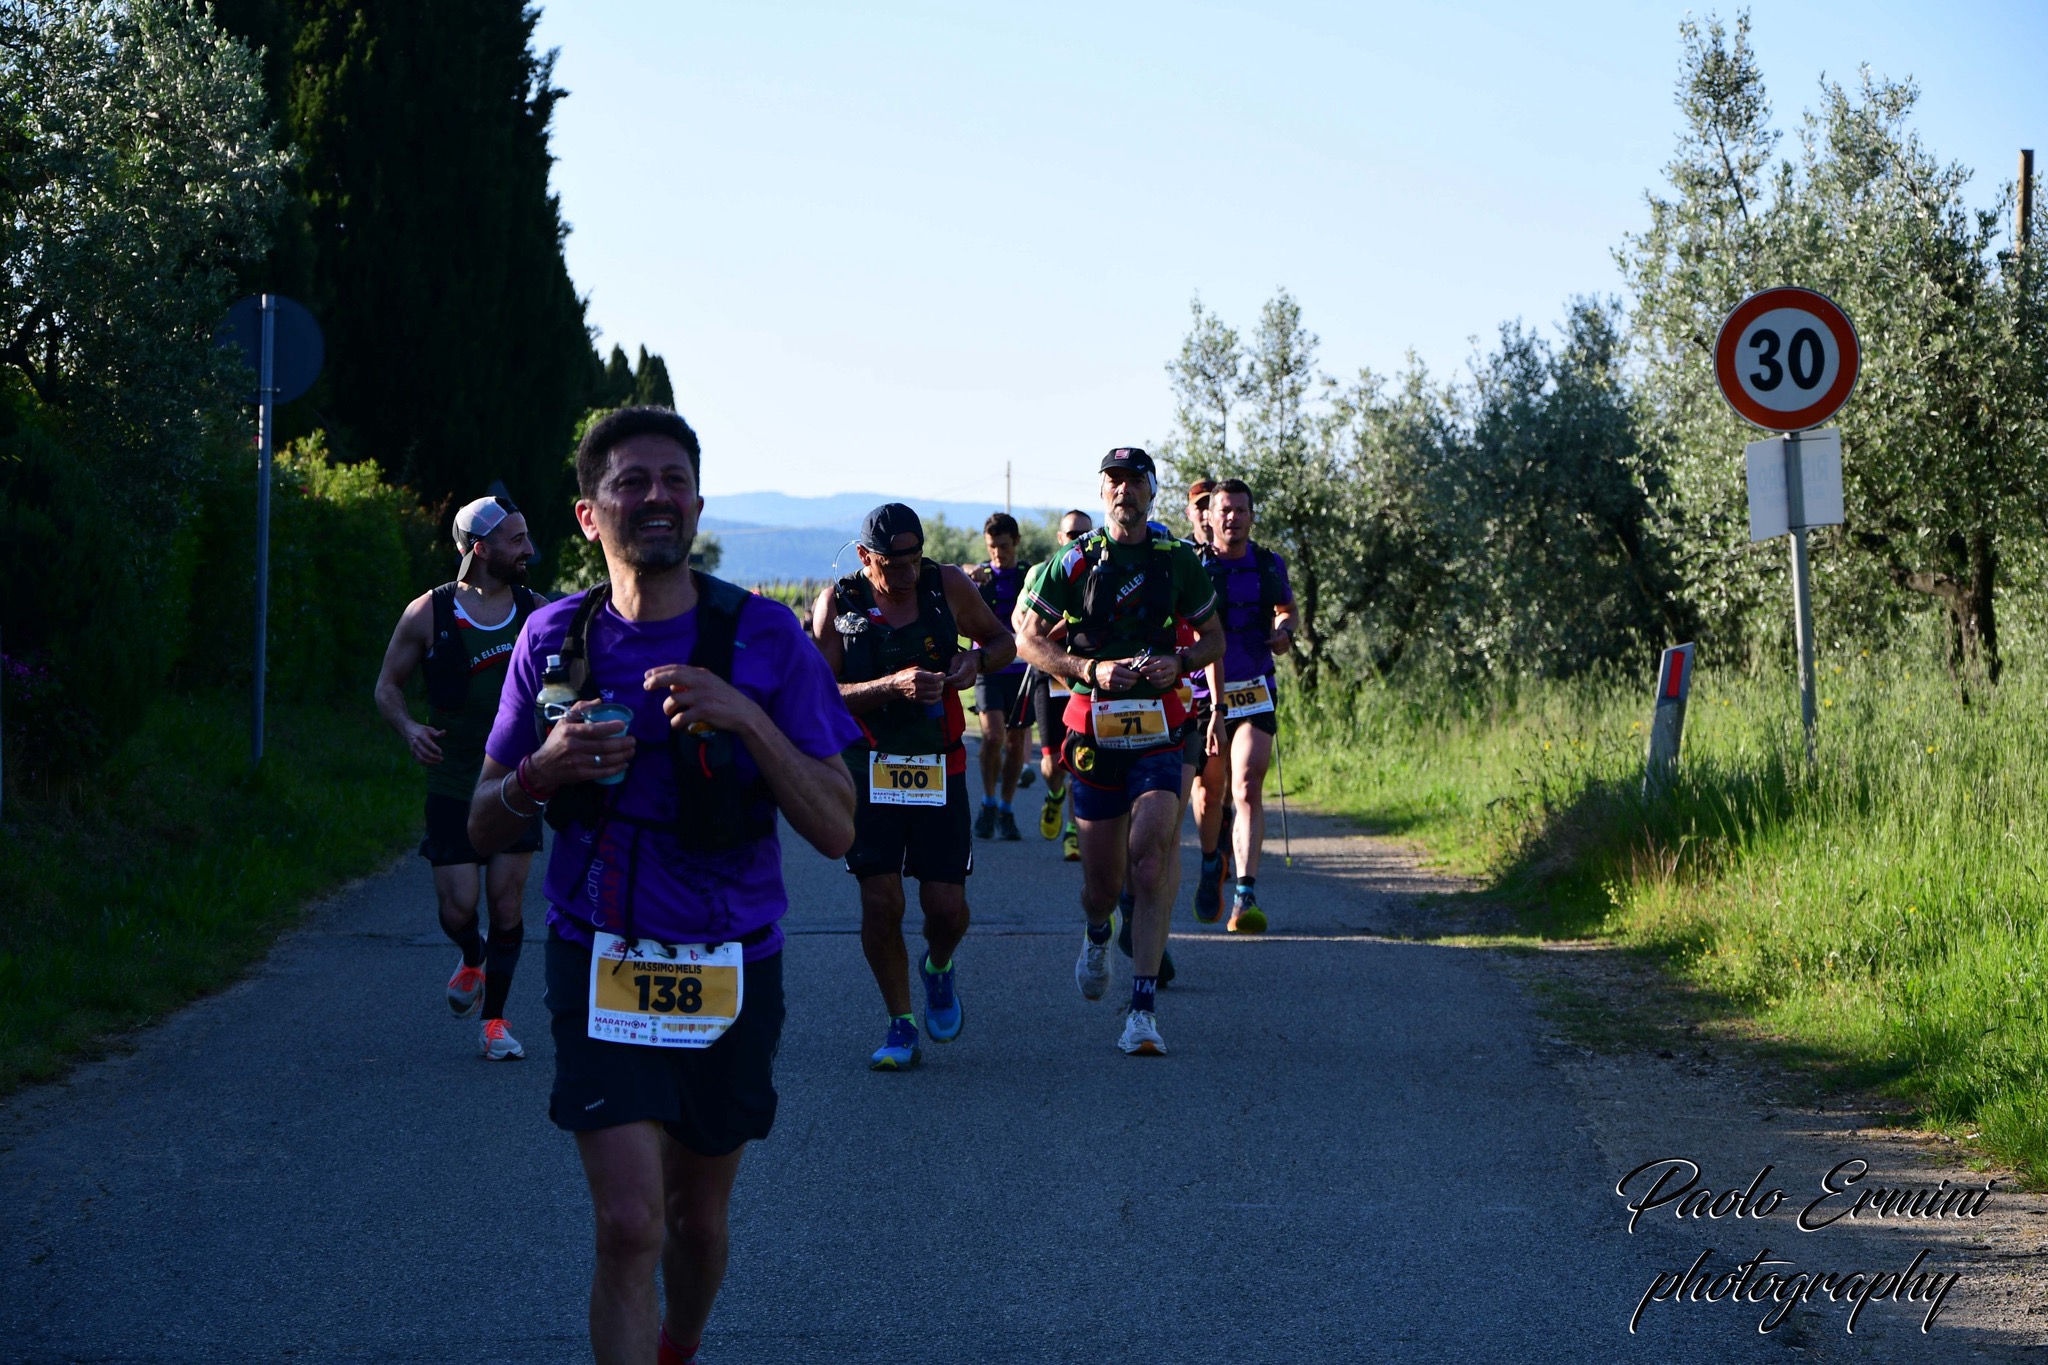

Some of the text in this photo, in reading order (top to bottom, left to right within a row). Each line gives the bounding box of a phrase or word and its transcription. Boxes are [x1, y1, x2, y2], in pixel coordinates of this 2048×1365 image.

[1749, 327, 1825, 392] 30
[1120, 571, 1146, 597] ELLER
[480, 642, 514, 660] ELLERA
[1228, 691, 1256, 707] 108
[1121, 717, 1142, 736] 71
[889, 770, 928, 789] 100
[633, 961, 702, 974] MASSIMO MELIS
[634, 975, 703, 1014] 138
[594, 1016, 647, 1029] MARATHON
